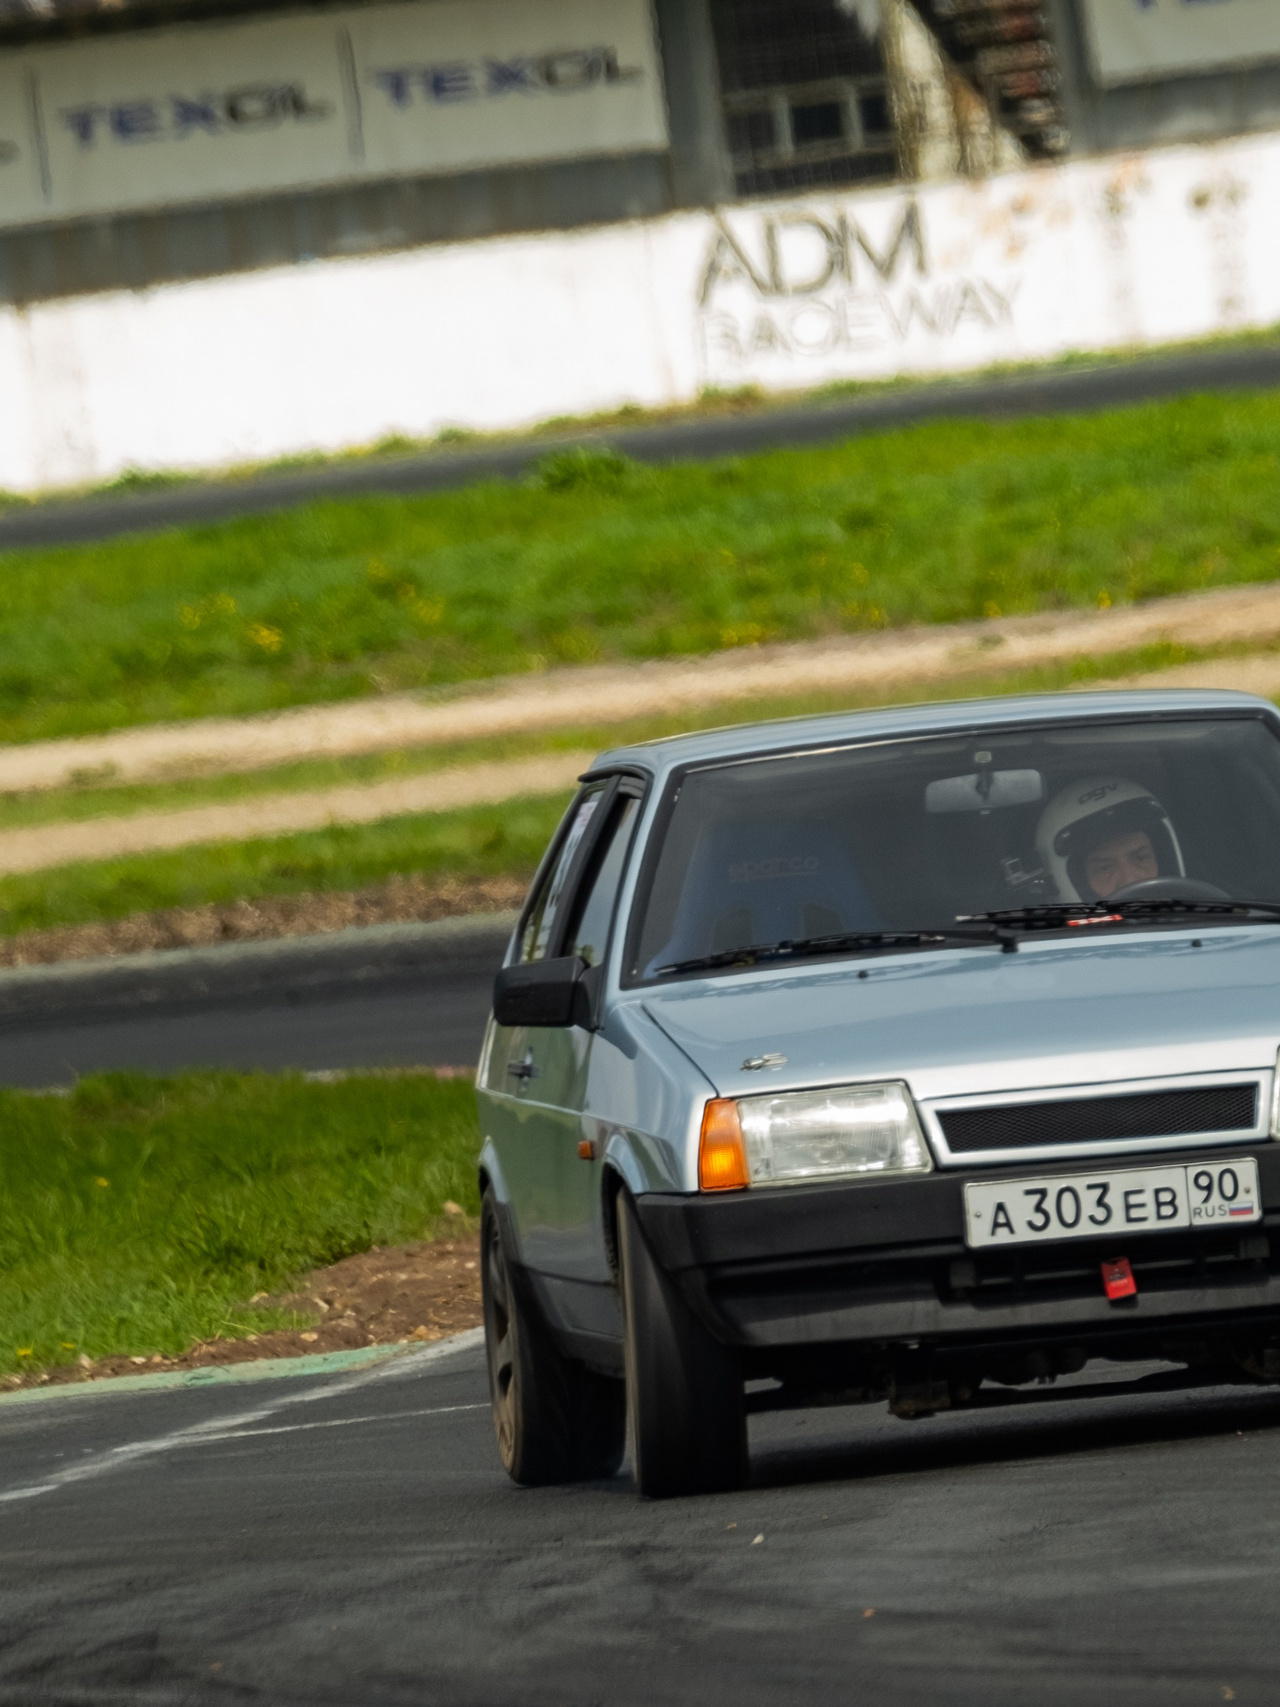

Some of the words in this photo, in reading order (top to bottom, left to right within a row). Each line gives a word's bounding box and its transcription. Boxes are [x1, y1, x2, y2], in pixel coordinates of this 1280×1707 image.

[372, 46, 643, 107] TEXOL
[60, 84, 332, 148] TEXOL
[698, 200, 926, 303] ADM
[700, 277, 1020, 362] RACEWAY
[1193, 1168, 1239, 1203] 90
[1193, 1204, 1227, 1218] RUS
